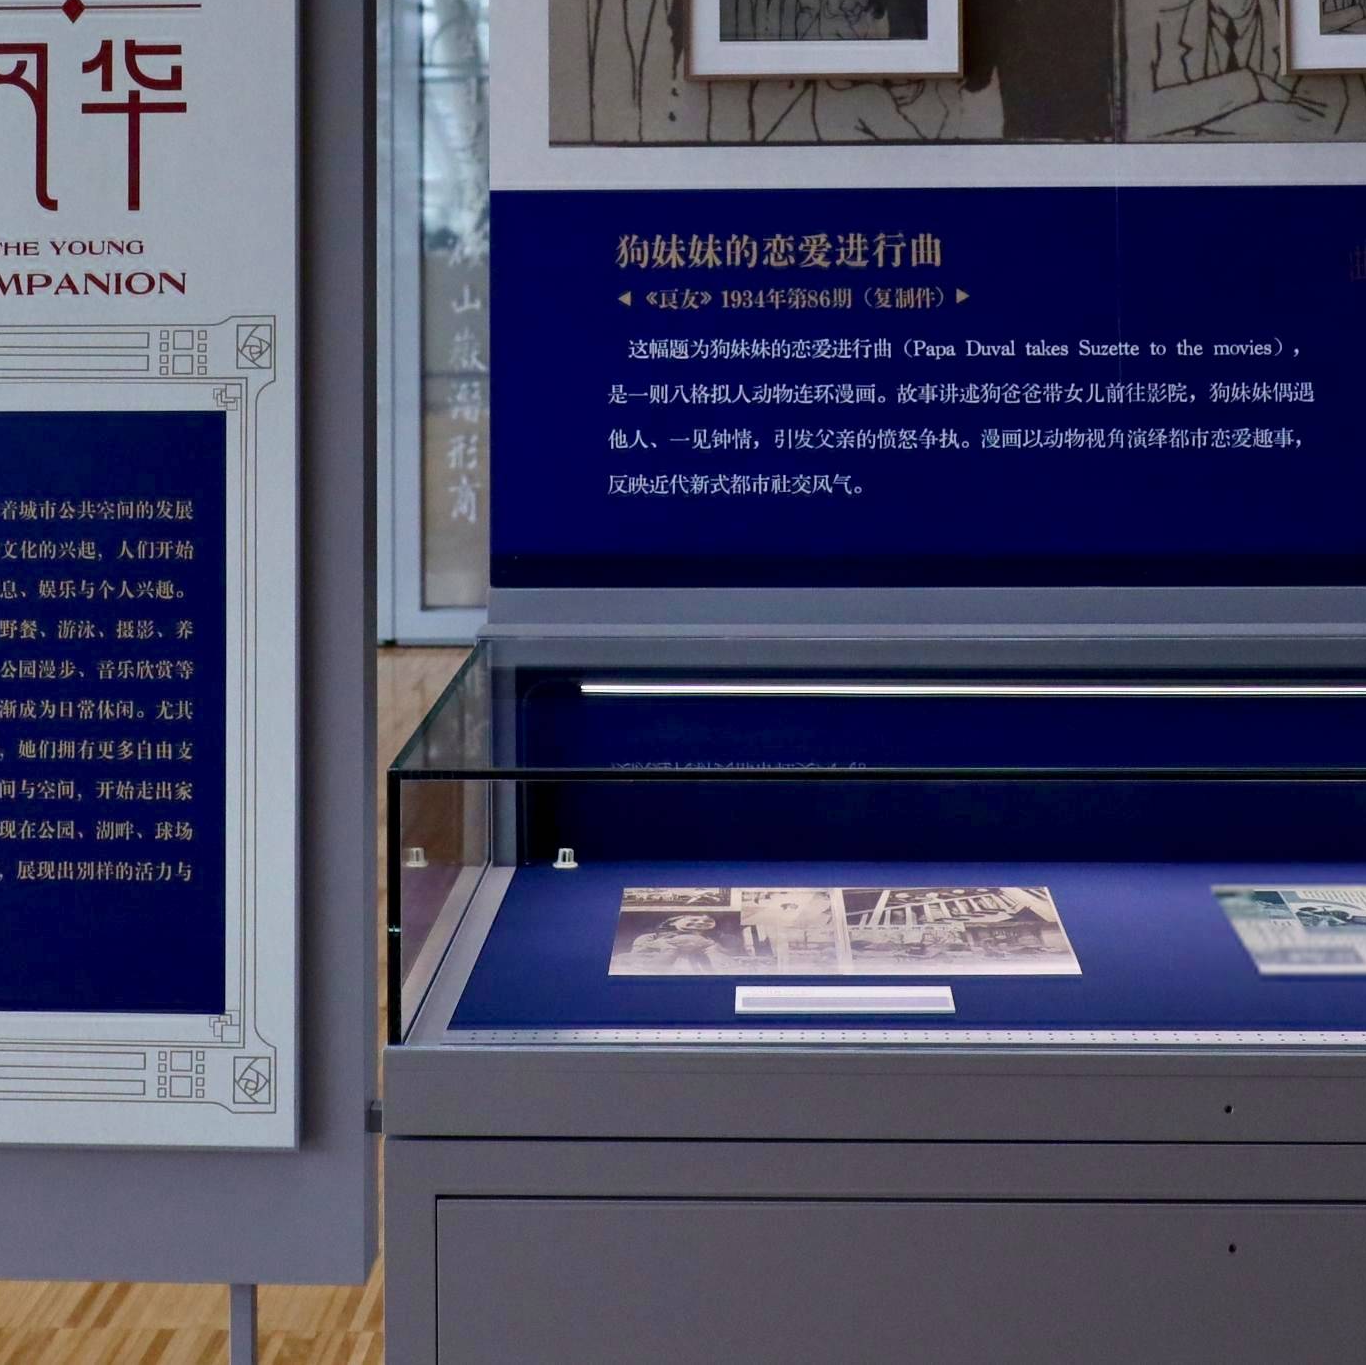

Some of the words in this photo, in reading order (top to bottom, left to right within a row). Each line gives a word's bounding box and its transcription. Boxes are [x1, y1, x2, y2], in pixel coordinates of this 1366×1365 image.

[50, 239, 145, 256] YOUNG
[615, 233, 943, 269] 狗妹妹的恋爱进行曲
[965, 339, 1016, 357] Duval
[1025, 339, 1069, 356] takes
[1078, 339, 1140, 356] Suzette
[1149, 341, 1166, 356] to
[1176, 339, 1204, 356] the
[607, 382, 1316, 405] 是一则八格拟人动物连环漫画。故事讲述狗爸爸带女儿前往影院，狗妹妹偶遇
[608, 428, 1303, 451] 他人、一见钟情，引发父亲的愤怒争执。漫画以动物视角演绎都市恋爱趣事，
[608, 474, 864, 496] 反映近代新式都市社交风气。
